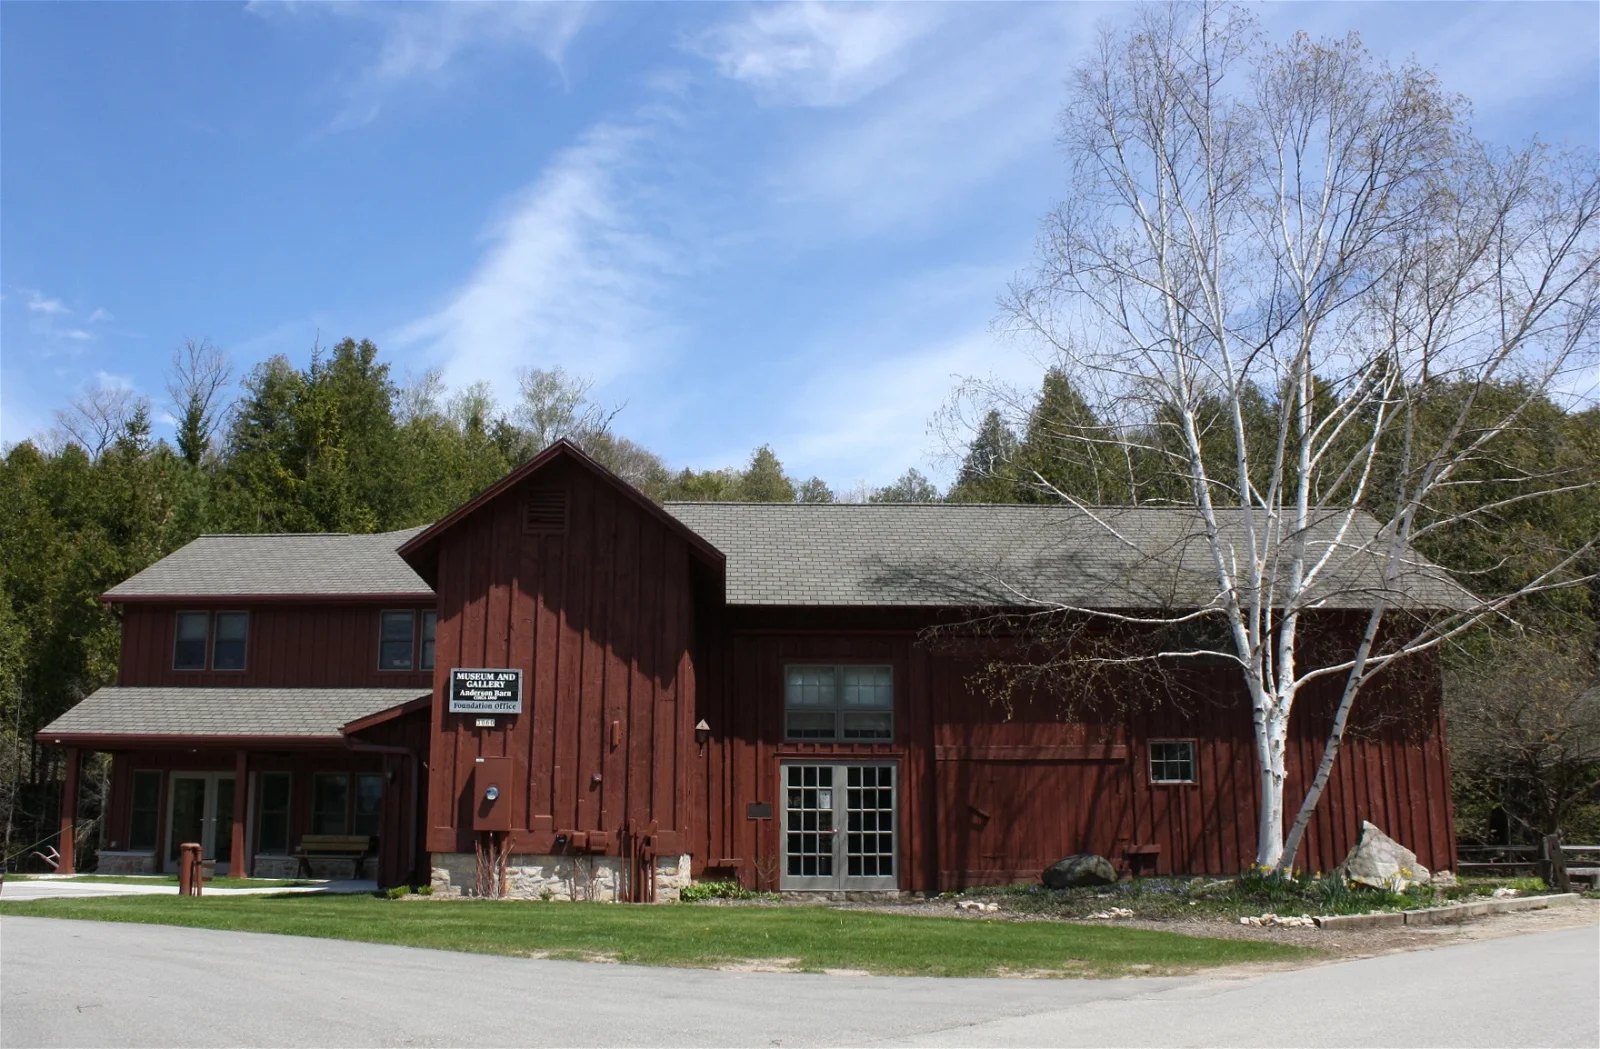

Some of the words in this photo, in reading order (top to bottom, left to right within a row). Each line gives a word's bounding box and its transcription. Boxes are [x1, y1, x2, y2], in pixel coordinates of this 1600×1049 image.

[497, 673, 516, 681] AND
[466, 680, 506, 688] GALLERY
[453, 702, 493, 710] Foundation
